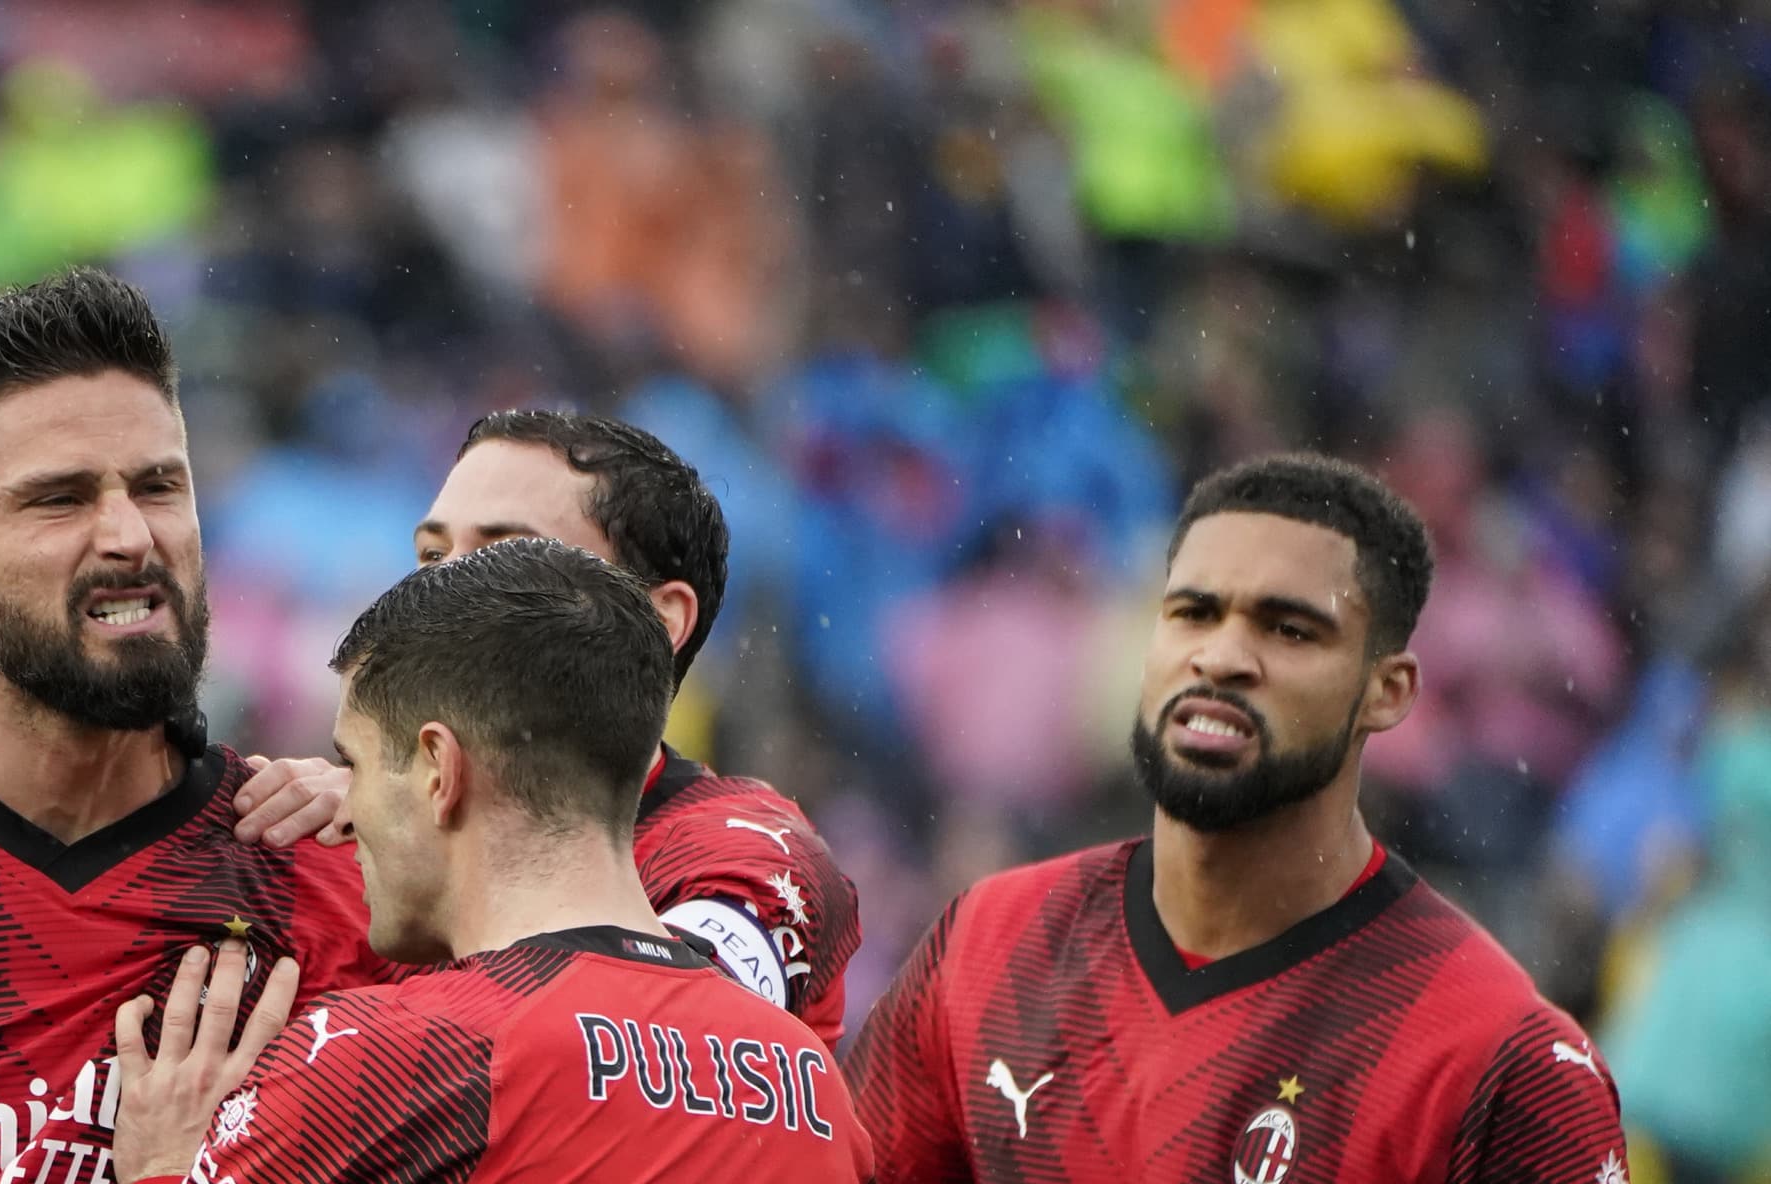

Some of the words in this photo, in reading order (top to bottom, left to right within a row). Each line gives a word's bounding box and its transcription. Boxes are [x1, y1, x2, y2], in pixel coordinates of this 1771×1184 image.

[699, 918, 777, 1004] PEAC
[576, 1013, 833, 1141] PULISIC
[1257, 1112, 1292, 1138] ACM
